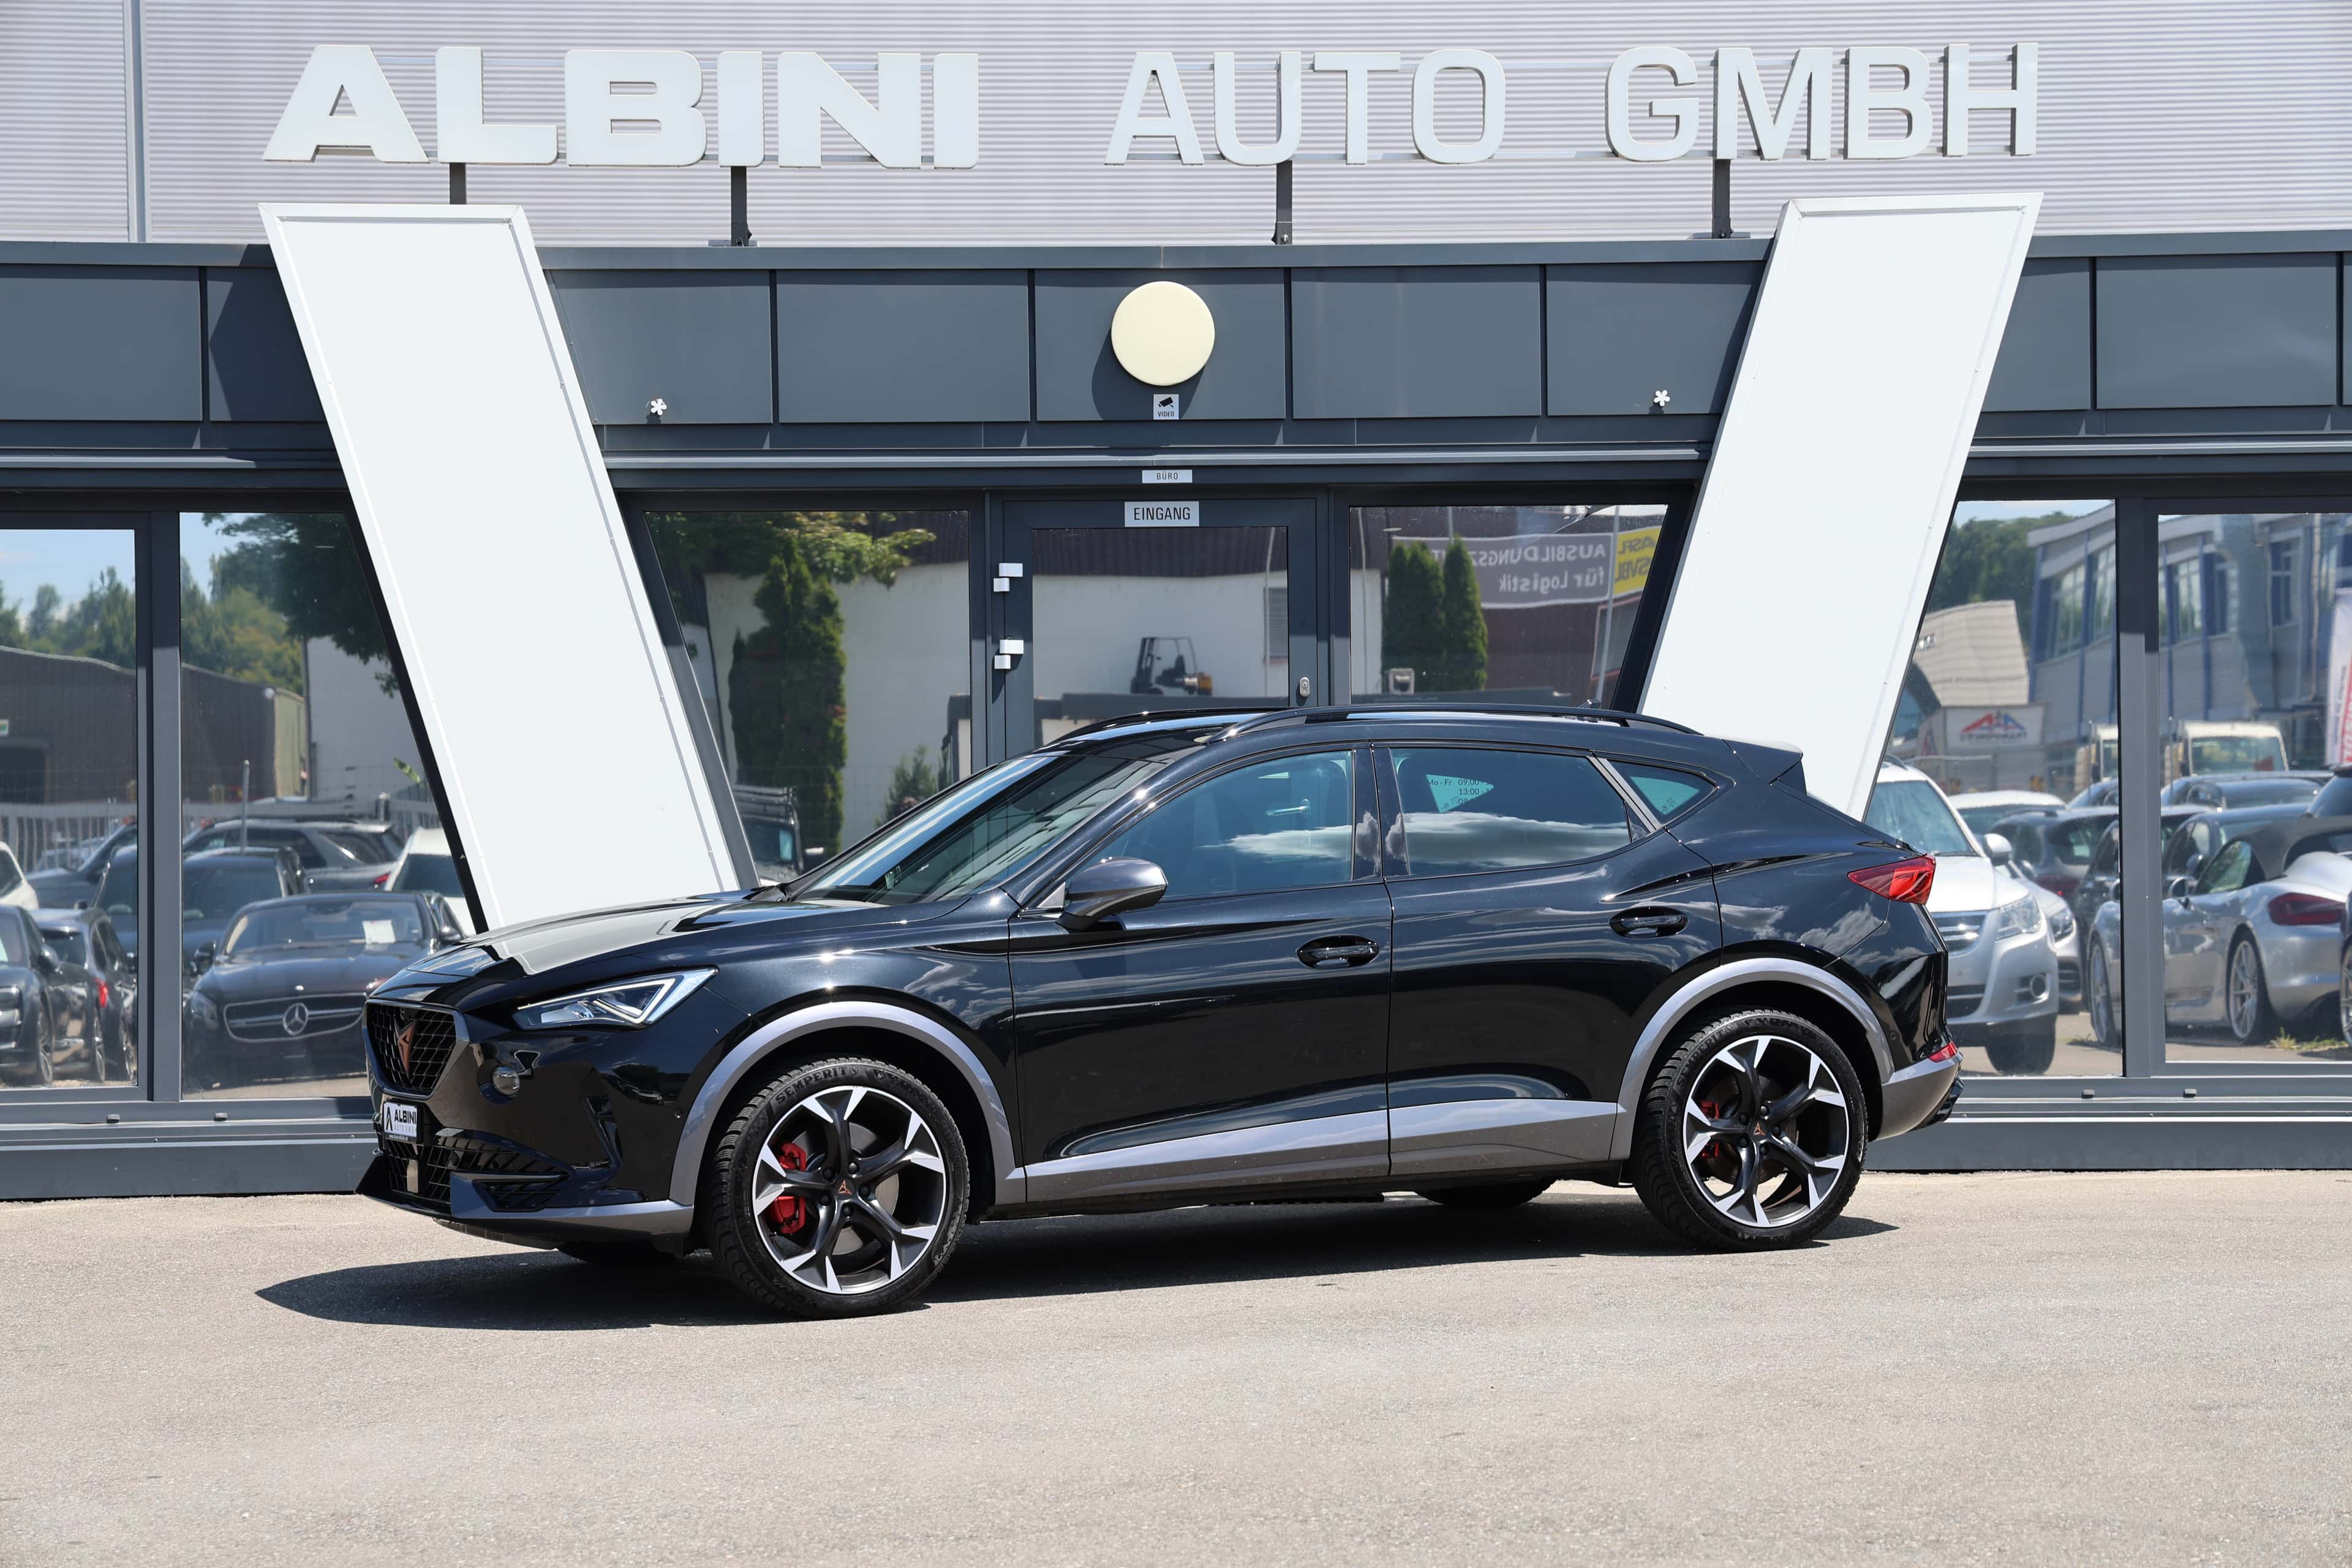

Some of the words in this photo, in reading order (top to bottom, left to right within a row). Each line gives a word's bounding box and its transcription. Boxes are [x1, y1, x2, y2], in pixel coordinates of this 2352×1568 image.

[262, 43, 979, 170] ALBINI
[1104, 48, 1506, 167] AUTO
[1604, 41, 2039, 162] GMBH
[1156, 471, 1178, 480] BÜRO
[1134, 507, 1191, 521] EINGANG
[394, 1109, 417, 1125] ALBINI
